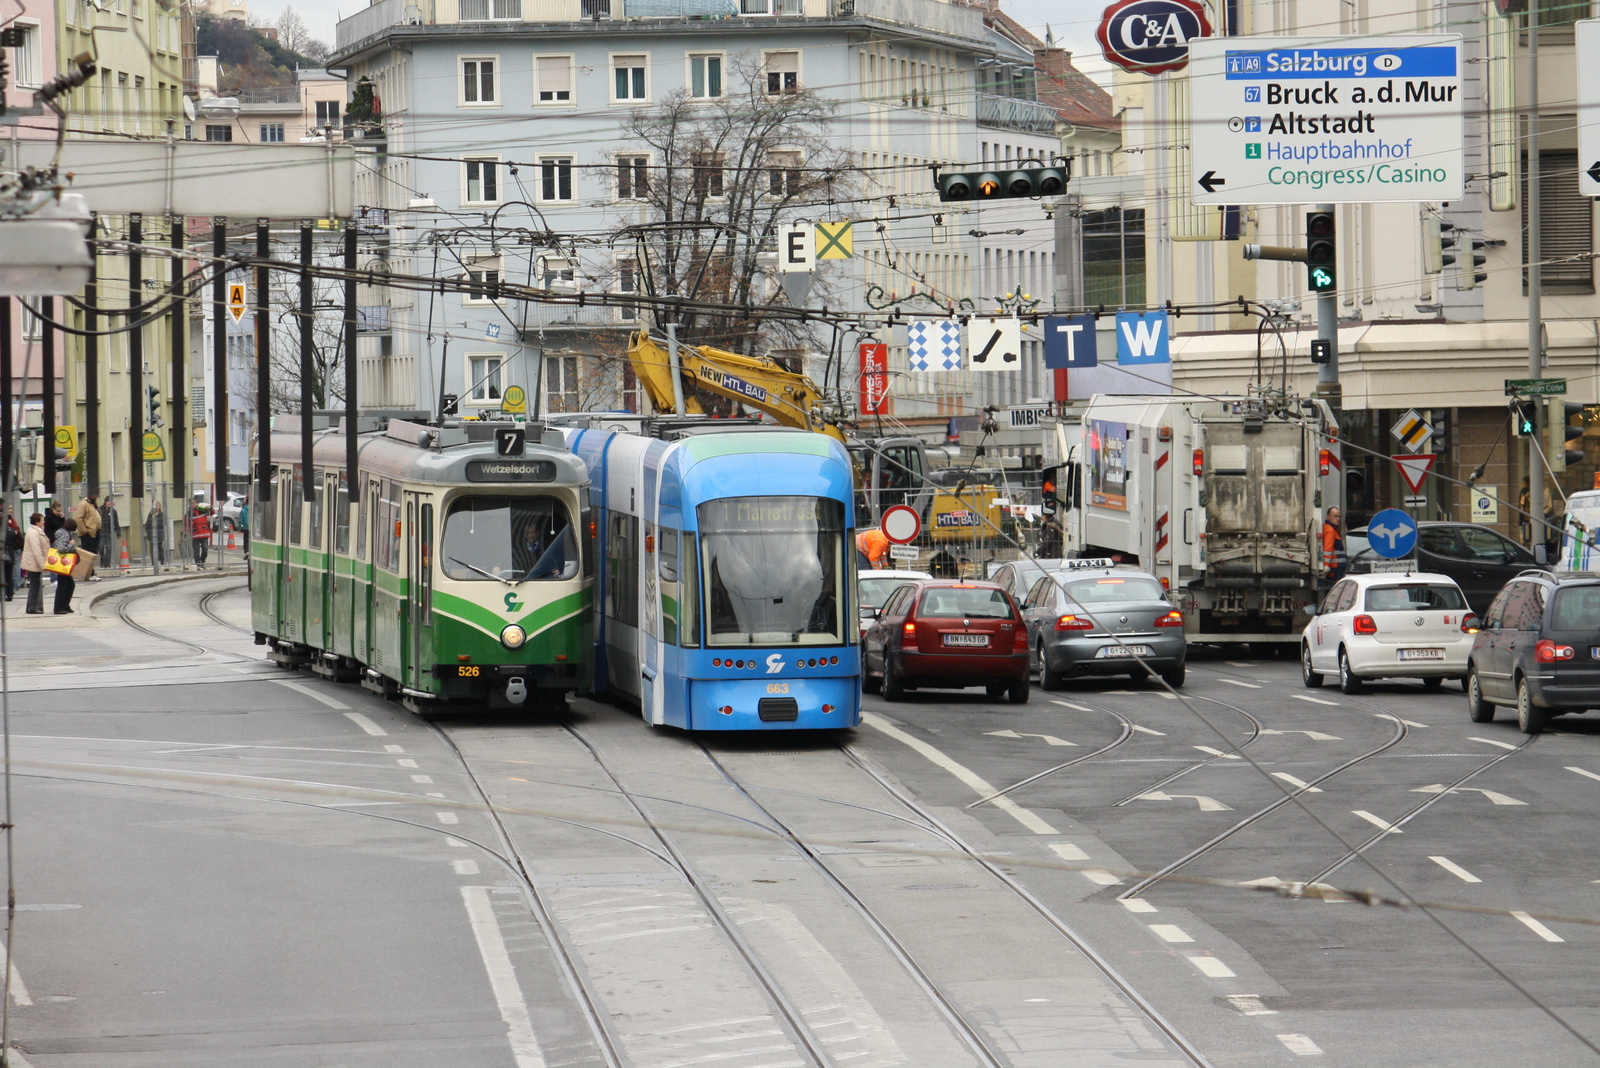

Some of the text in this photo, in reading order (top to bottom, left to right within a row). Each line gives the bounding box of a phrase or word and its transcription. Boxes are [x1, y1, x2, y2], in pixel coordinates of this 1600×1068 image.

[1121, 13, 1189, 50] C&A
[1246, 51, 1393, 76] A9 Salzburg D
[1245, 88, 1260, 101] 67
[1267, 81, 1340, 105] Bruck
[1268, 110, 1375, 135] Altstadt
[1267, 138, 1412, 165] Hauptbahnhof
[1268, 163, 1447, 189] Congress/Casino
[788, 232, 806, 263] E
[232, 287, 242, 303] A
[489, 325, 500, 336] W
[1057, 324, 1083, 361] T
[1121, 320, 1162, 357] W
[700, 365, 767, 400] NEW HTL BAU
[504, 433, 517, 454] 7
[481, 464, 540, 474] Wetzelsdorf
[722, 503, 729, 522] 1
[458, 666, 480, 677] 526
[766, 683, 790, 694] 663
